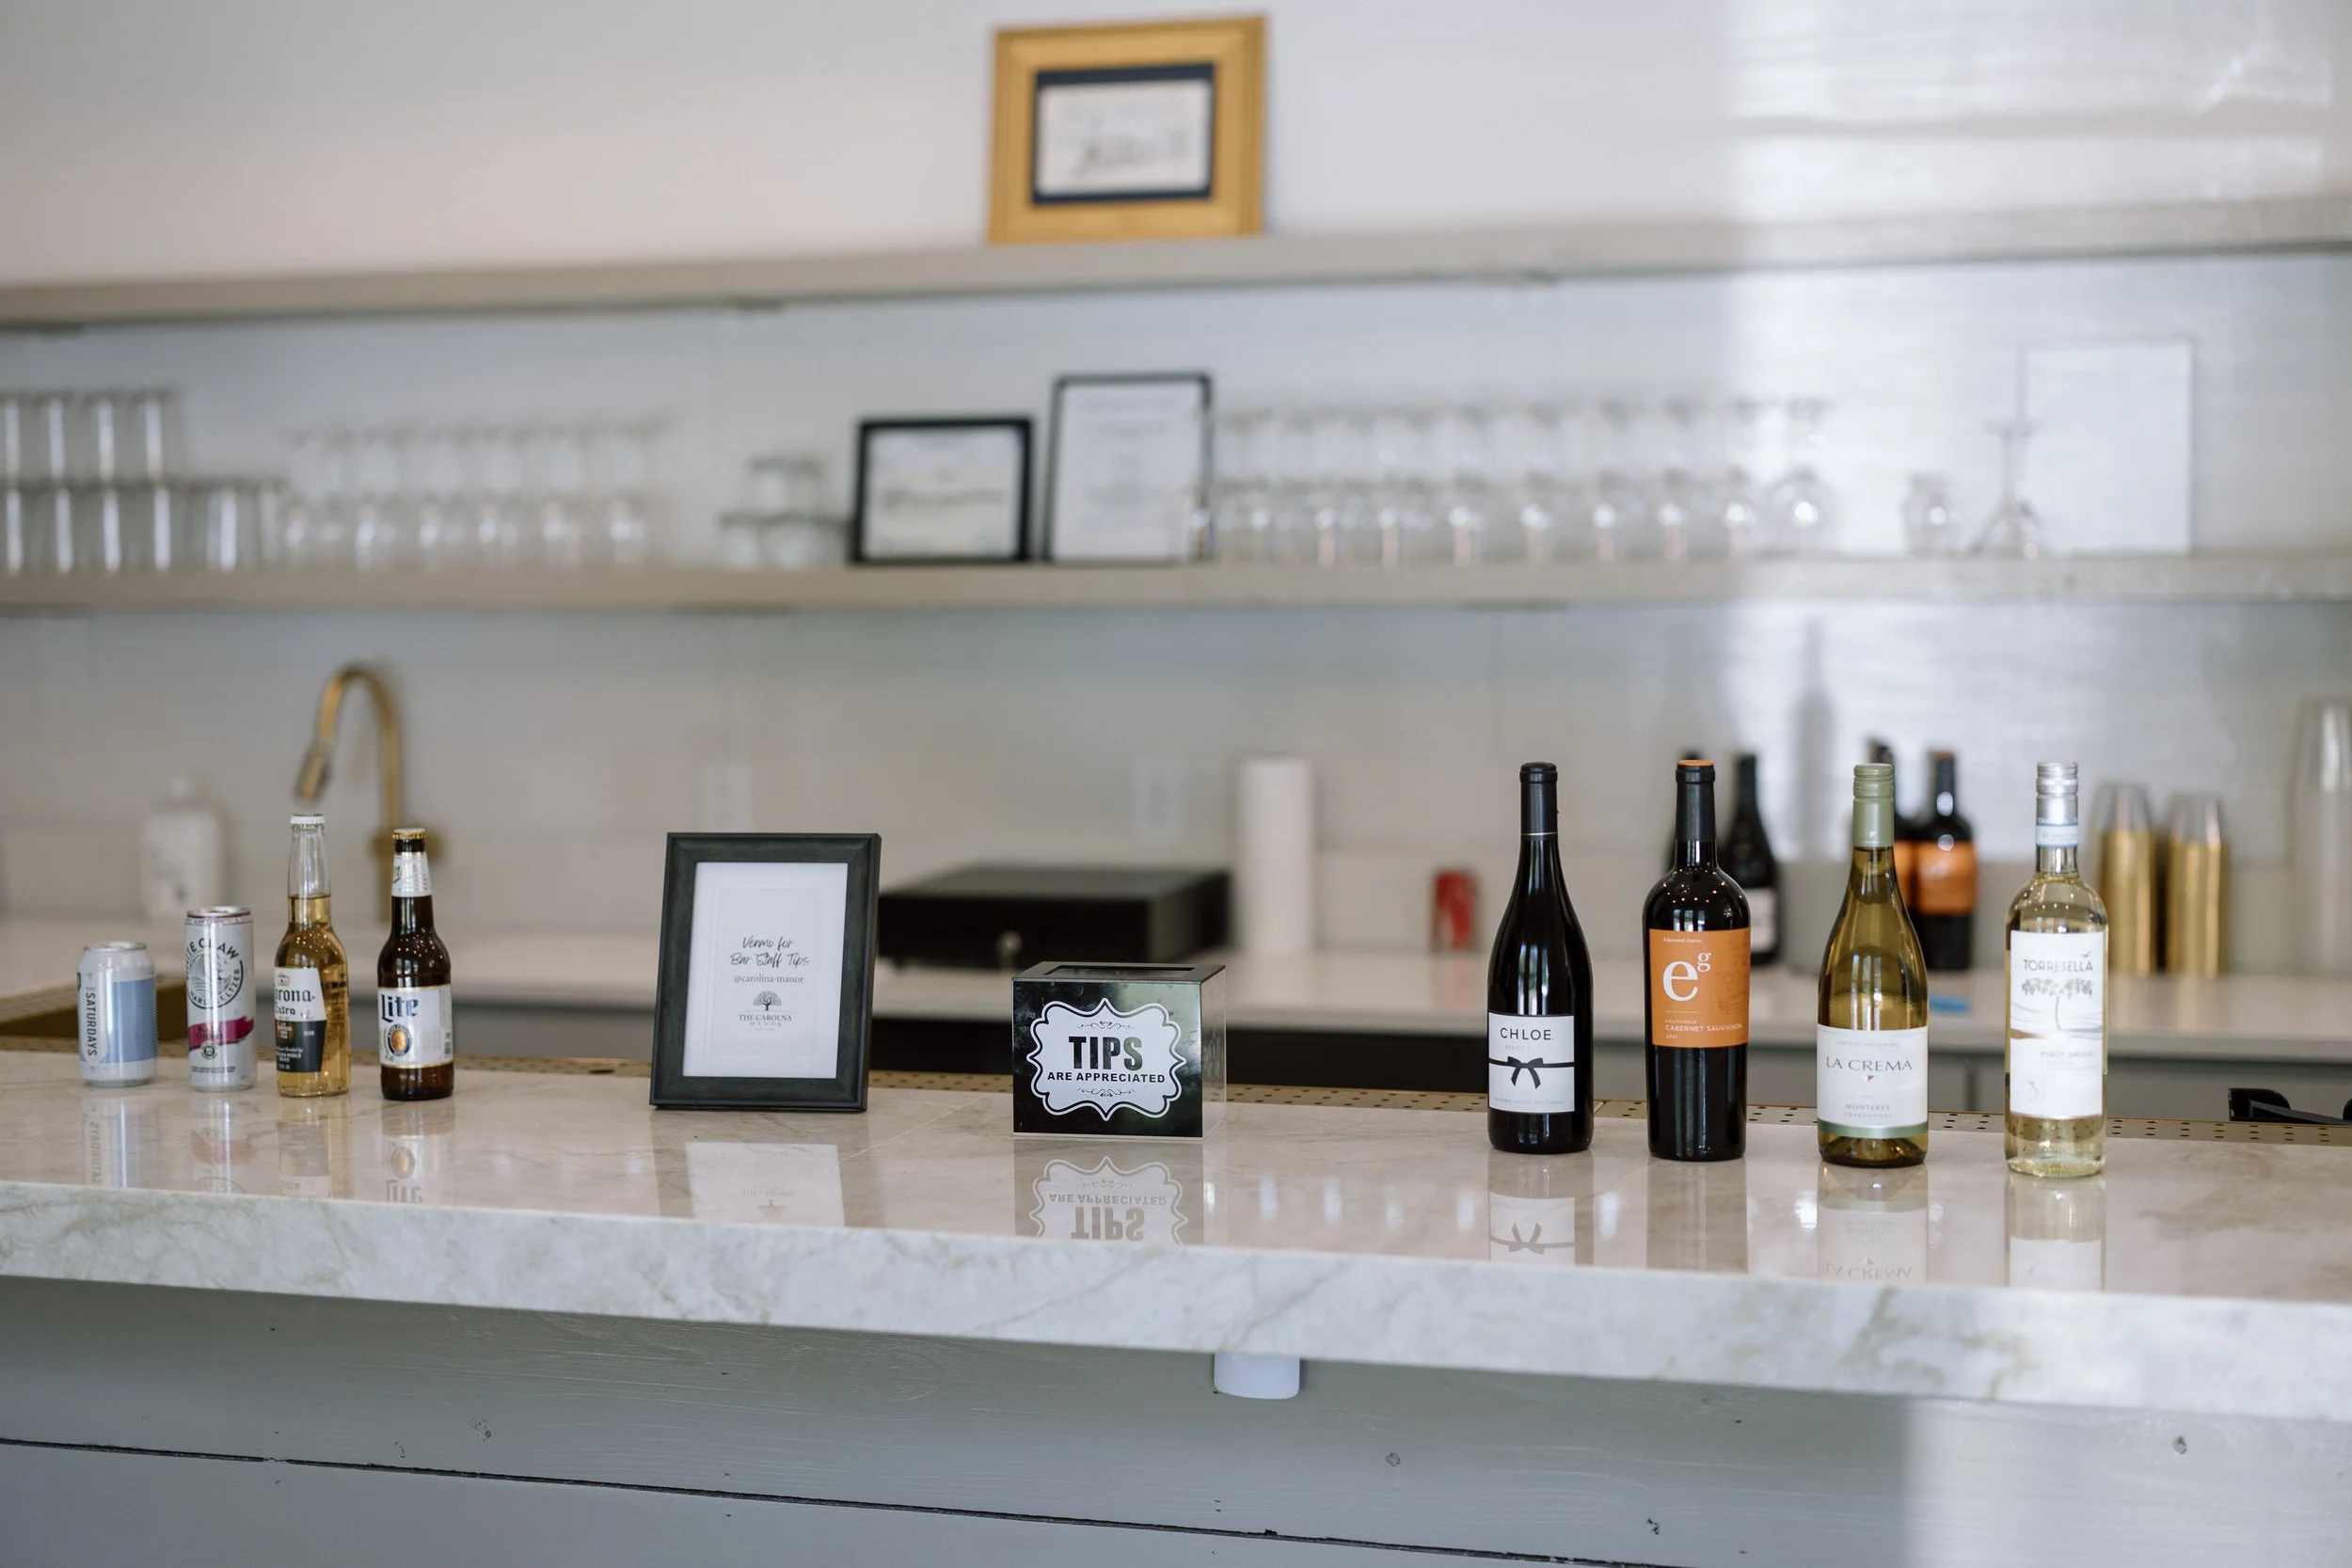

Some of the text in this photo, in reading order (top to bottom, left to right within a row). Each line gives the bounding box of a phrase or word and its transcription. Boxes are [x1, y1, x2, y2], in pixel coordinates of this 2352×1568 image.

[742, 935, 794, 951] Venmo for
[730, 952, 809, 968] Bar Staff Tips
[2023, 958, 2093, 973] TORRESELLA
[734, 974, 804, 984] @carolina-manor
[276, 989, 312, 1002] orona
[380, 994, 420, 1022] Lite
[86, 992, 98, 1056] SATURDAYS
[1707, 1022, 1742, 1032] SAUVIGNON
[1068, 1036, 1144, 1071] TIPS
[1826, 1055, 1913, 1071] LA CREMA
[1047, 1072, 1166, 1084] ARE APPRECIATED
